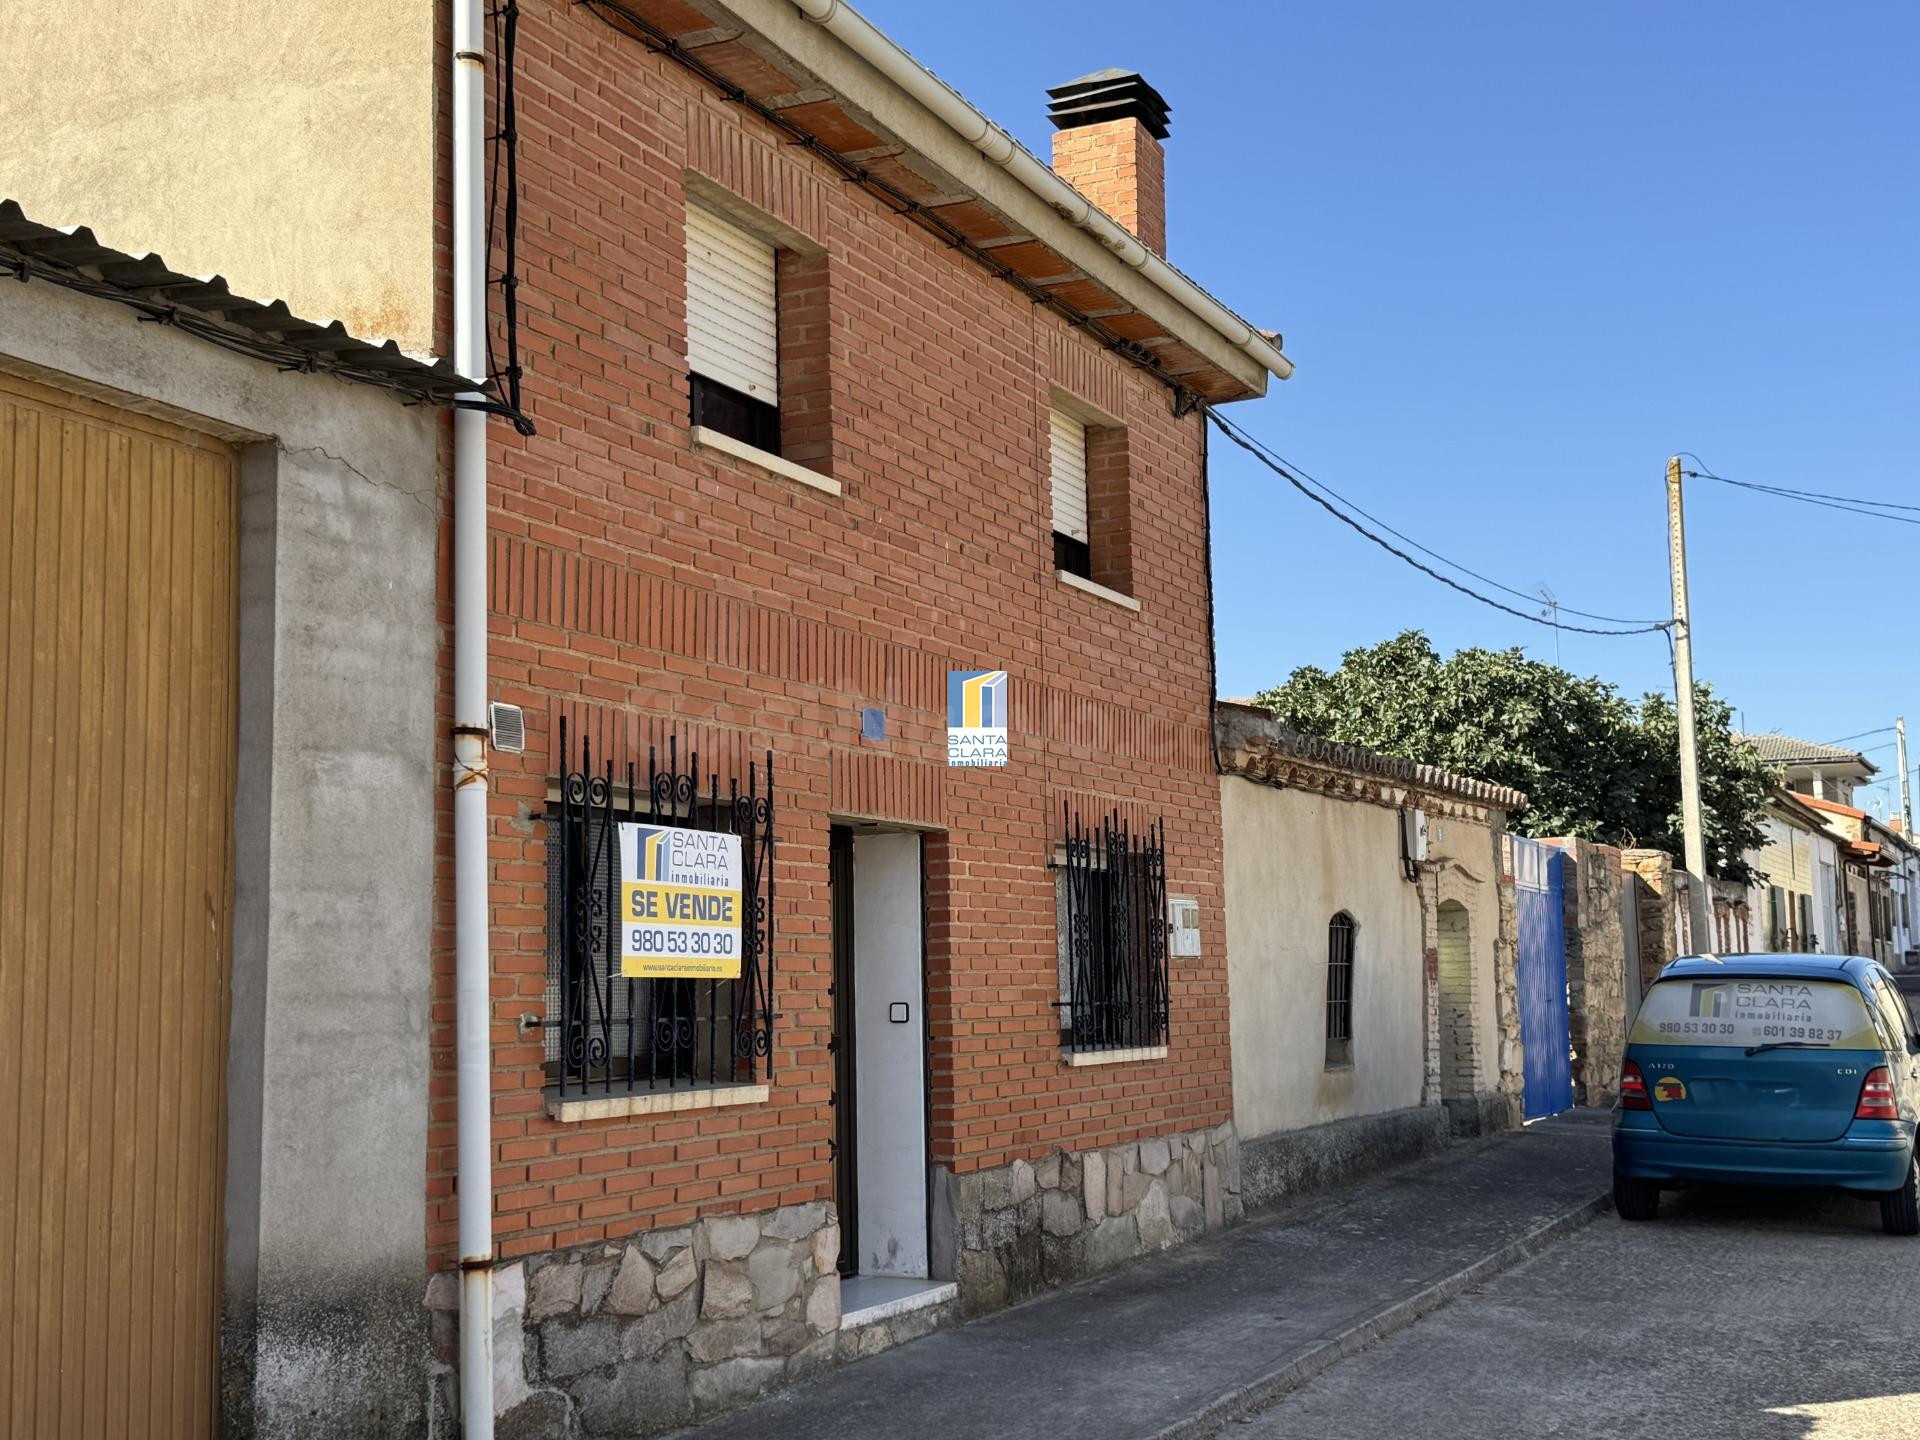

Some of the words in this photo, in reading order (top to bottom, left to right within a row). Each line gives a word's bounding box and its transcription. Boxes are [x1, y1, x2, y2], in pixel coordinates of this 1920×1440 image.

[673, 831, 729, 853] SANTA
[672, 850, 729, 871] CLARA
[671, 870, 729, 887] inmobiliaria
[631, 889, 658, 918] SE
[664, 892, 733, 922] VENDE
[631, 929, 664, 953] 980
[667, 930, 688, 953] 53
[691, 932, 711, 954] 30
[713, 933, 733, 955] 30
[1737, 983, 1813, 997] SANTA
[1736, 996, 1812, 1010] CLARA
[1735, 1010, 1812, 1022] inmobiliaria
[1659, 1022, 1681, 1033] 980
[1684, 1022, 1699, 1034] 53
[1701, 1023, 1716, 1034] 30
[1719, 1023, 1735, 1034] 30
[1763, 1025, 1785, 1037] 601
[1789, 1026, 1805, 1038] 39
[1808, 1028, 1824, 1039] 82
[1827, 1029, 1842, 1040] 37
